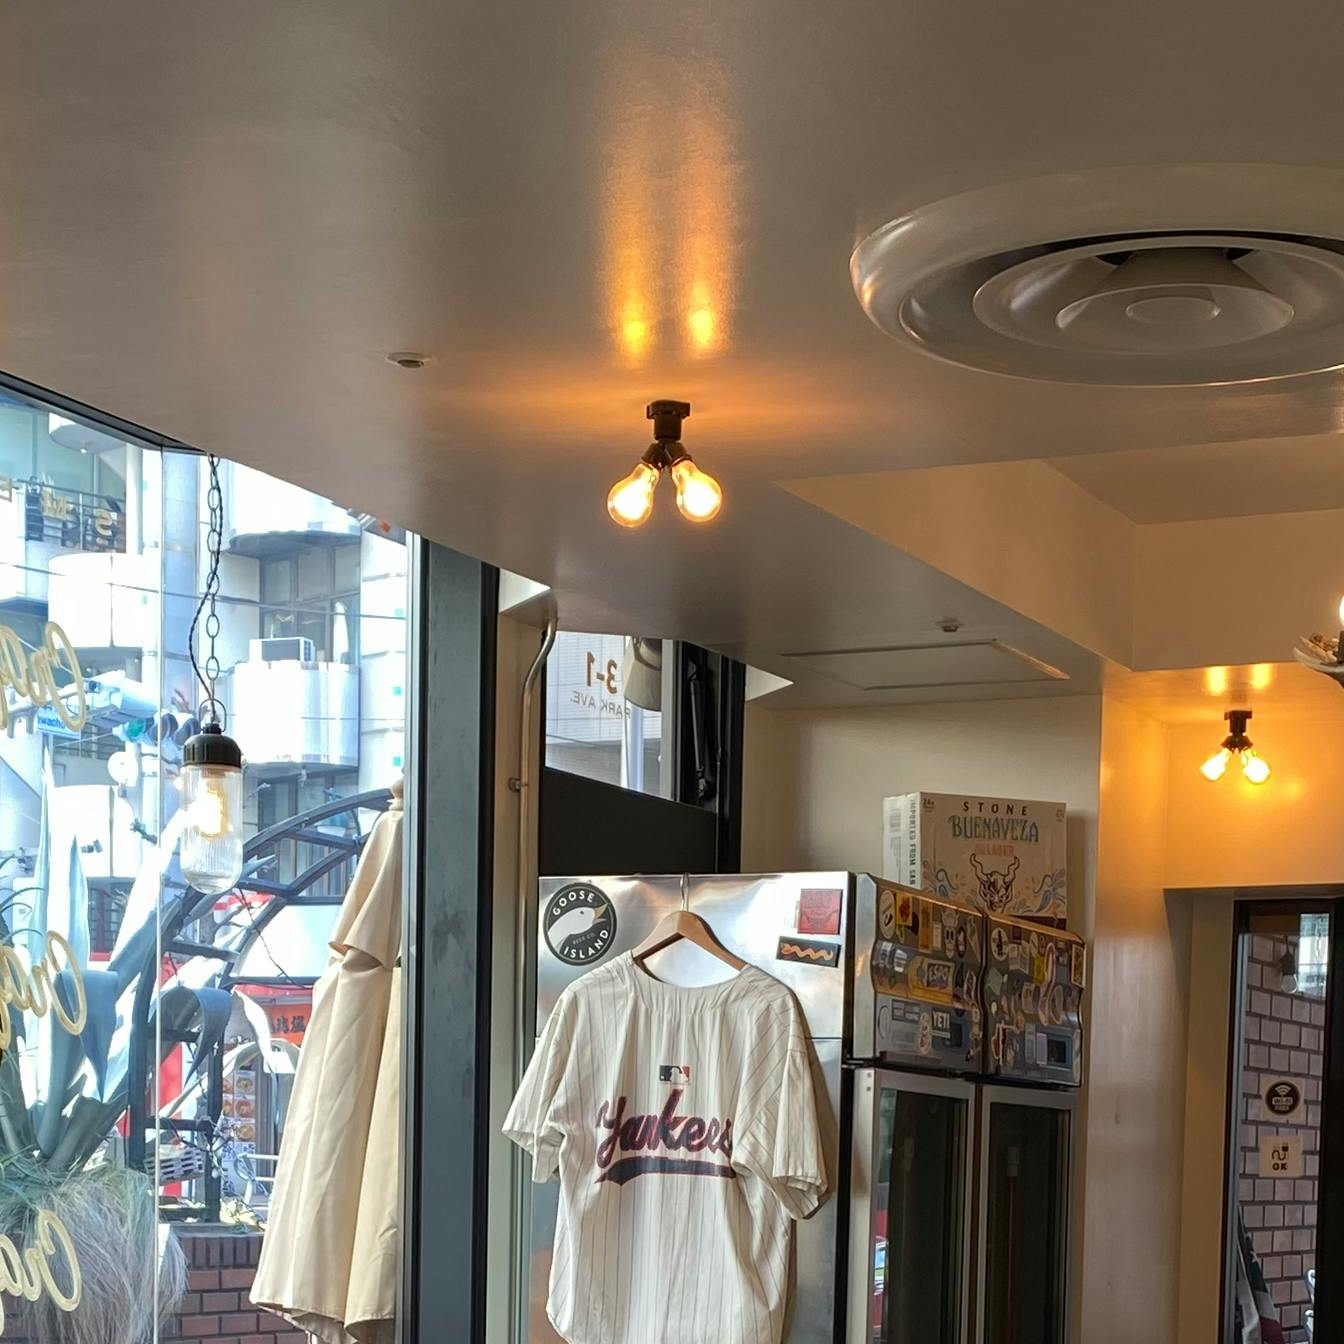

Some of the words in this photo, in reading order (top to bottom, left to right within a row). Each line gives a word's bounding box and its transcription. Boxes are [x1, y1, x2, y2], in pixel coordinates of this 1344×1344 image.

[963, 801, 1029, 816] STONE
[950, 815, 1040, 843] BUENAVEZA
[552, 890, 595, 916] GOOSE
[563, 930, 609, 958] ISLAND
[932, 1011, 951, 1029] YETI
[595, 1088, 733, 1169] Yankees
[1272, 1162, 1288, 1171] OK
